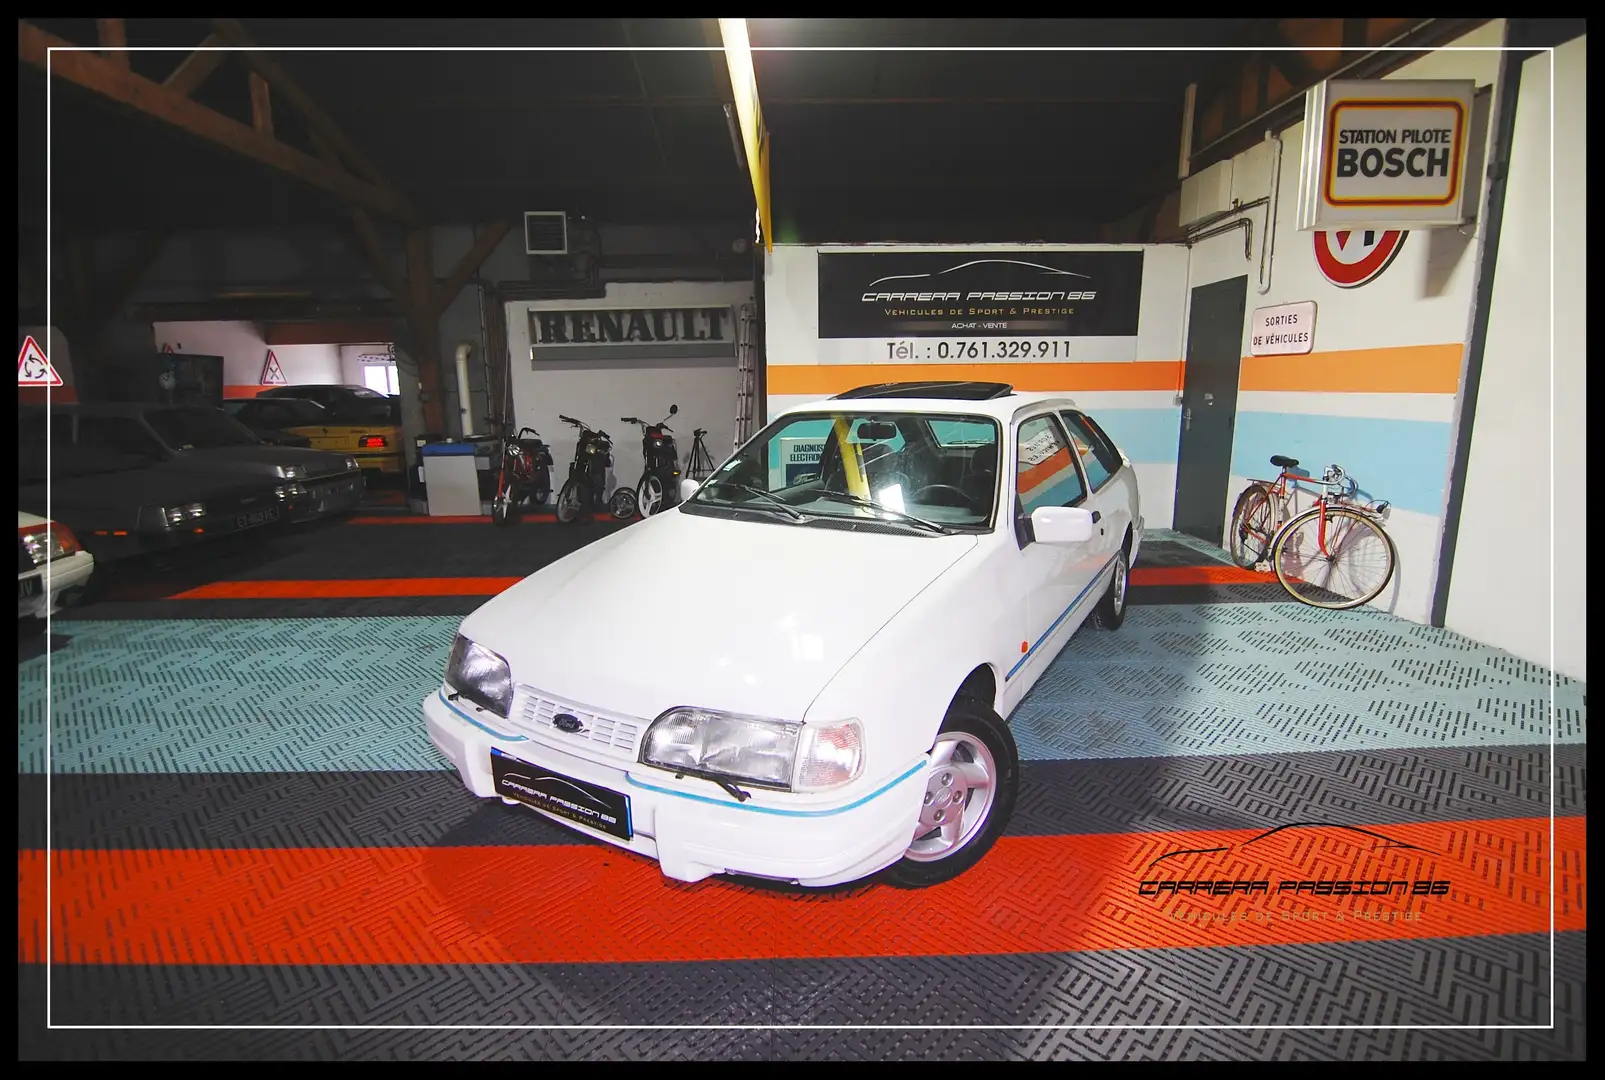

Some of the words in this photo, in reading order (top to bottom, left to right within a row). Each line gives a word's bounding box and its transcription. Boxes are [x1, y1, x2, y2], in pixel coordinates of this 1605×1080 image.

[1339, 128, 1398, 145] STATION
[1401, 128, 1452, 143] PILOTE
[1336, 148, 1450, 178] BOSCH
[861, 291, 960, 301] CARRERA
[966, 290, 1064, 301] PASSION
[1067, 290, 1097, 300] 86
[968, 307, 1005, 315] SPORT
[1009, 307, 1017, 315] &
[1023, 307, 1075, 315] PRESTIGE
[539, 310, 728, 343] RENAULT
[1265, 314, 1298, 326] SORTIES
[1253, 335, 1262, 346] DE
[1265, 331, 1309, 345] VÉHICULES
[887, 340, 919, 360] Tél.
[937, 340, 1071, 358] 0.761.329.911
[793, 444, 824, 453] DIAGNOS
[501, 779, 548, 800] CARRERA
[549, 795, 600, 818] PASSION
